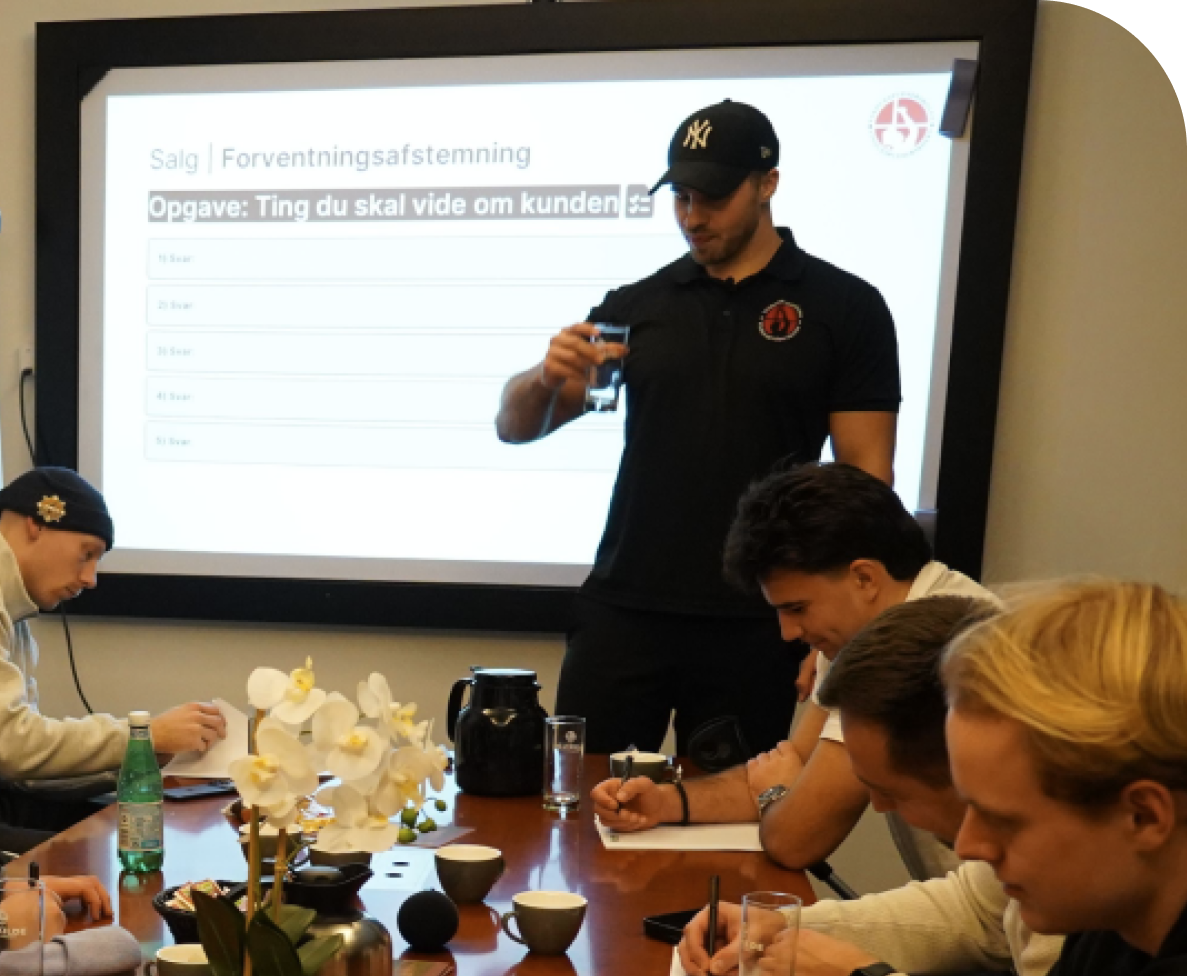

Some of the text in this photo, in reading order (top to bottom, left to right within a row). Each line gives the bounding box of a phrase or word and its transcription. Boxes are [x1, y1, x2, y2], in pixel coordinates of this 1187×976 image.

[150, 148, 199, 174] Salg
[222, 142, 532, 172] Forventningsafstemning
[150, 191, 620, 221] Opgave: Ting du skal vide om kunden
